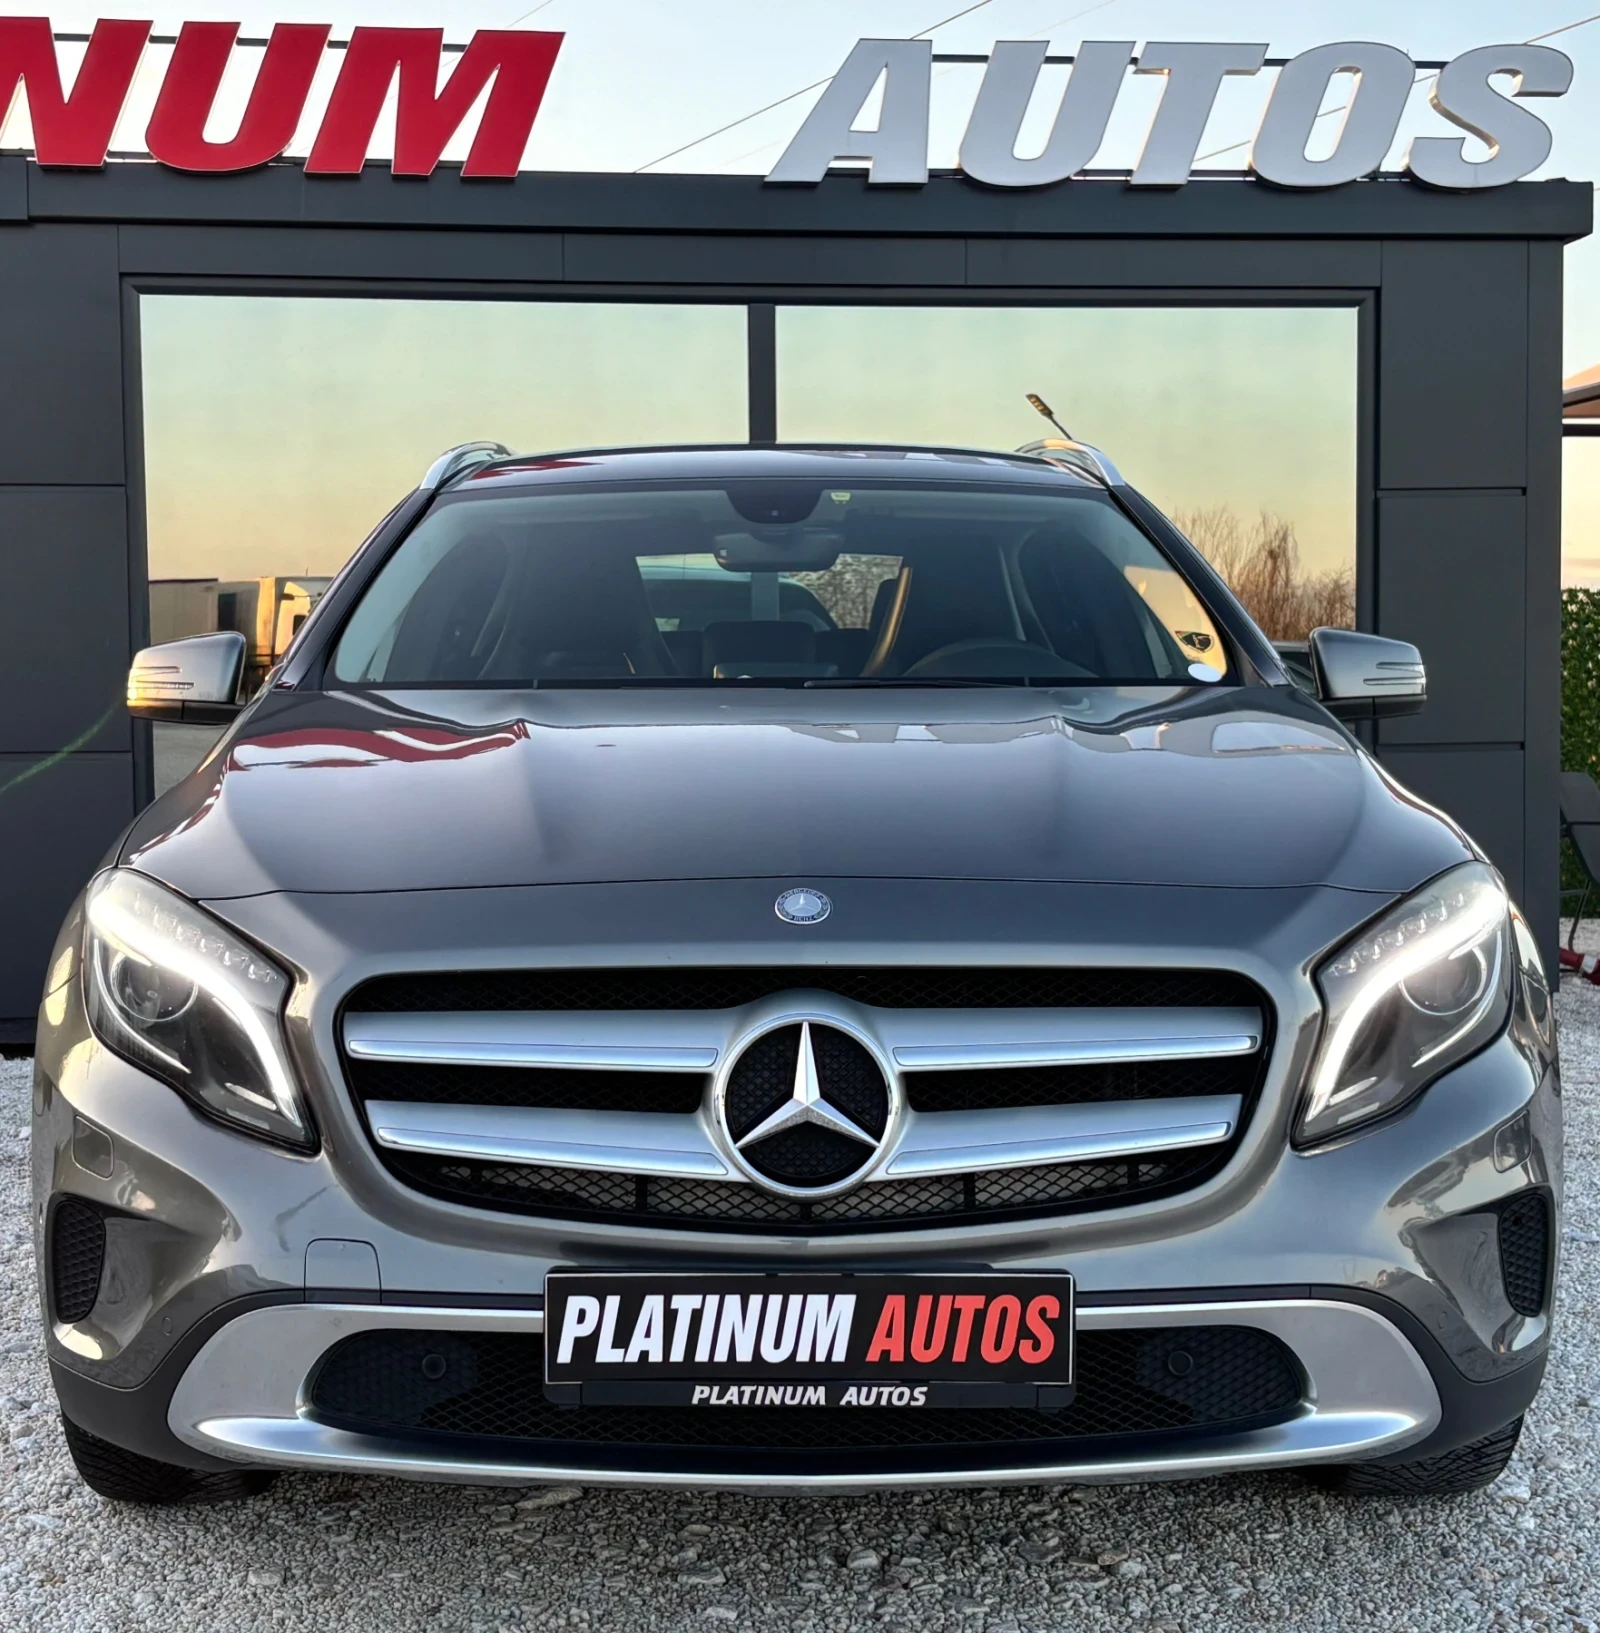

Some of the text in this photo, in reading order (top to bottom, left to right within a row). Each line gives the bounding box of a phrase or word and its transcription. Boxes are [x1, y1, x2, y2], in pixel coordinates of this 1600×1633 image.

[0, 17, 1574, 189] NUM AUTOS
[557, 1294, 1060, 1364] PLATINUM AUTOS
[692, 1385, 928, 1406] PLATINUM AUTOS
